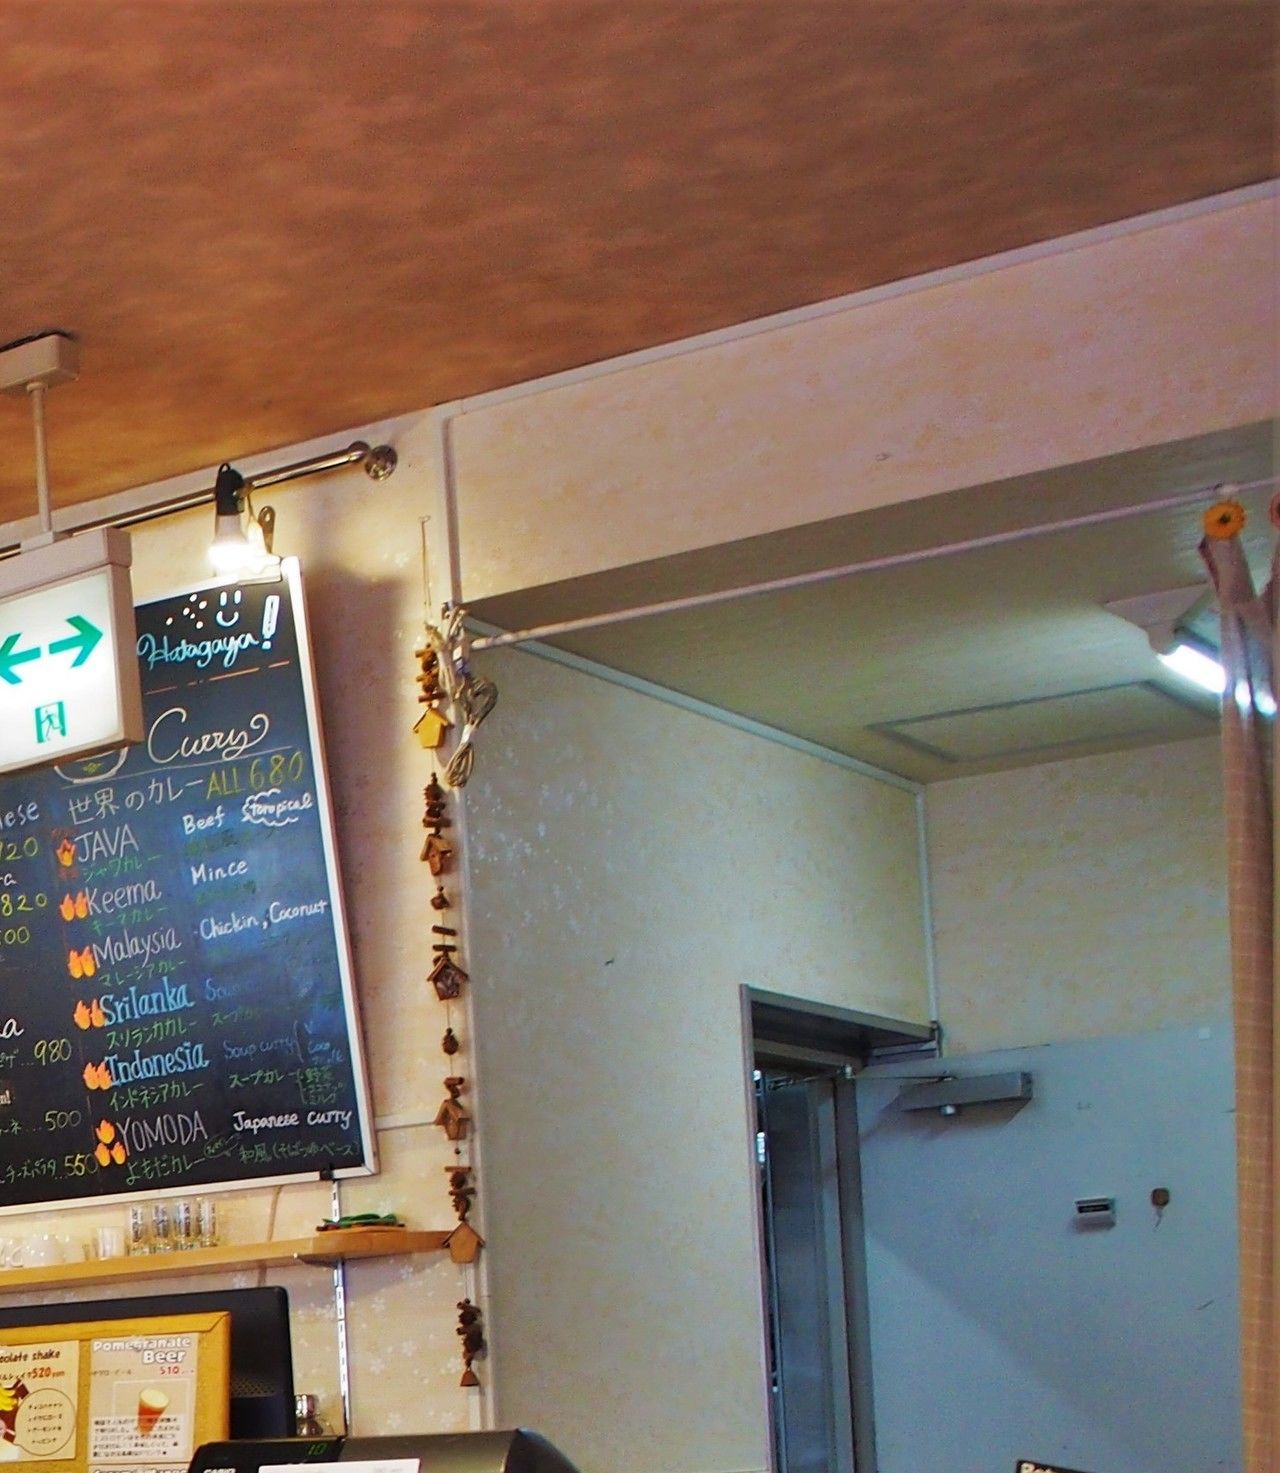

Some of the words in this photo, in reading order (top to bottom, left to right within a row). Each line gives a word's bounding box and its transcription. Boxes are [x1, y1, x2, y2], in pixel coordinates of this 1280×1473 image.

[147, 707, 269, 765] Curry
[67, 777, 204, 826] 世界のカレー
[206, 766, 238, 801] ALL
[249, 751, 304, 789] 680
[75, 823, 139, 863] JAVA
[182, 805, 225, 836] Beef
[1, 893, 48, 917] 820
[87, 878, 162, 917] Keema
[191, 858, 248, 886] Mince
[92, 926, 182, 969] Malaysia
[33, 1038, 72, 1064] 980
[105, 1041, 210, 1087] Indonesia
[44, 1110, 82, 1131] 500
[117, 1110, 208, 1157] YOMODA
[233, 1111, 299, 1135] Japanese
[32, 1349, 60, 1361] shake
[143, 1350, 187, 1365] Beer
[160, 1366, 179, 1375] 510
